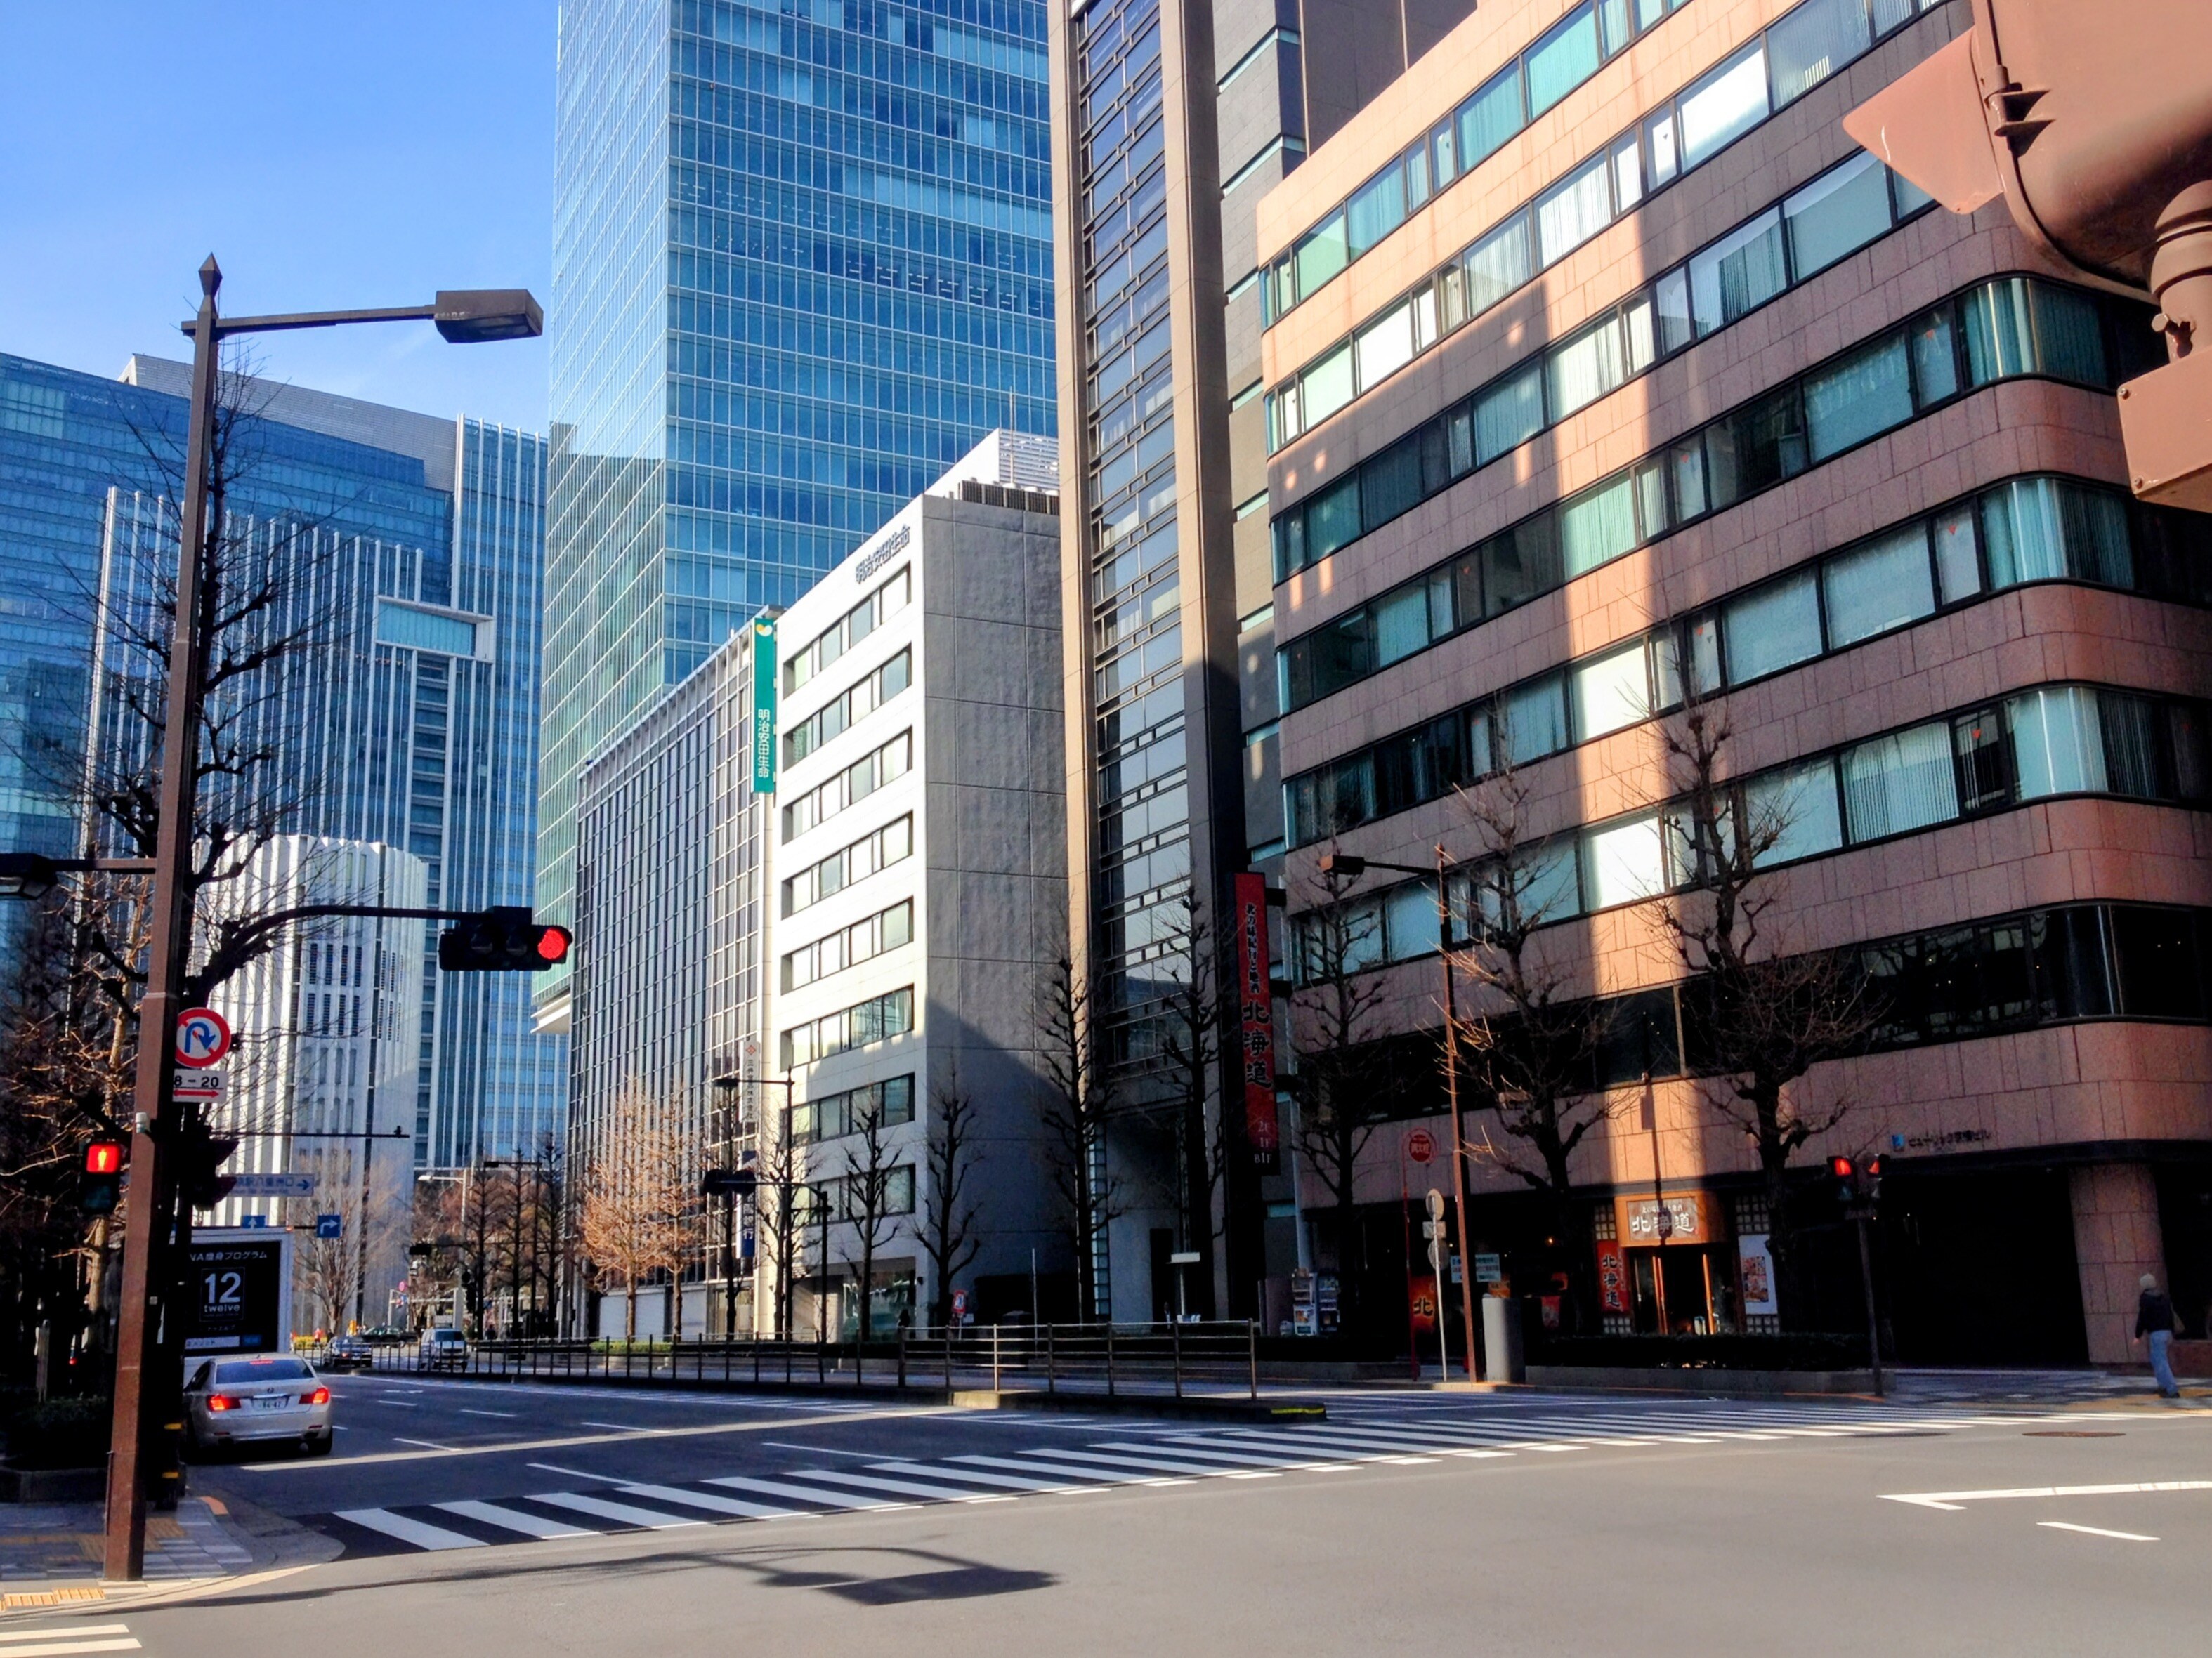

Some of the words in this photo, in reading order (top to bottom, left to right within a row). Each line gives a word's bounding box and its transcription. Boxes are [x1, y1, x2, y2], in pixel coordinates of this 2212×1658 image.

[856, 524, 910, 584] 明治安田生命
[758, 709, 770, 778] 明治安田生命
[1242, 1001, 1272, 1088] 北海道
[1254, 1152, 1272, 1164] B1F
[1632, 1213, 1694, 1232] 北海道
[204, 1272, 242, 1303] 12
[1602, 1255, 1620, 1307] 北海道
[204, 1304, 240, 1312] twelve
[1413, 1297, 1433, 1317] 北
